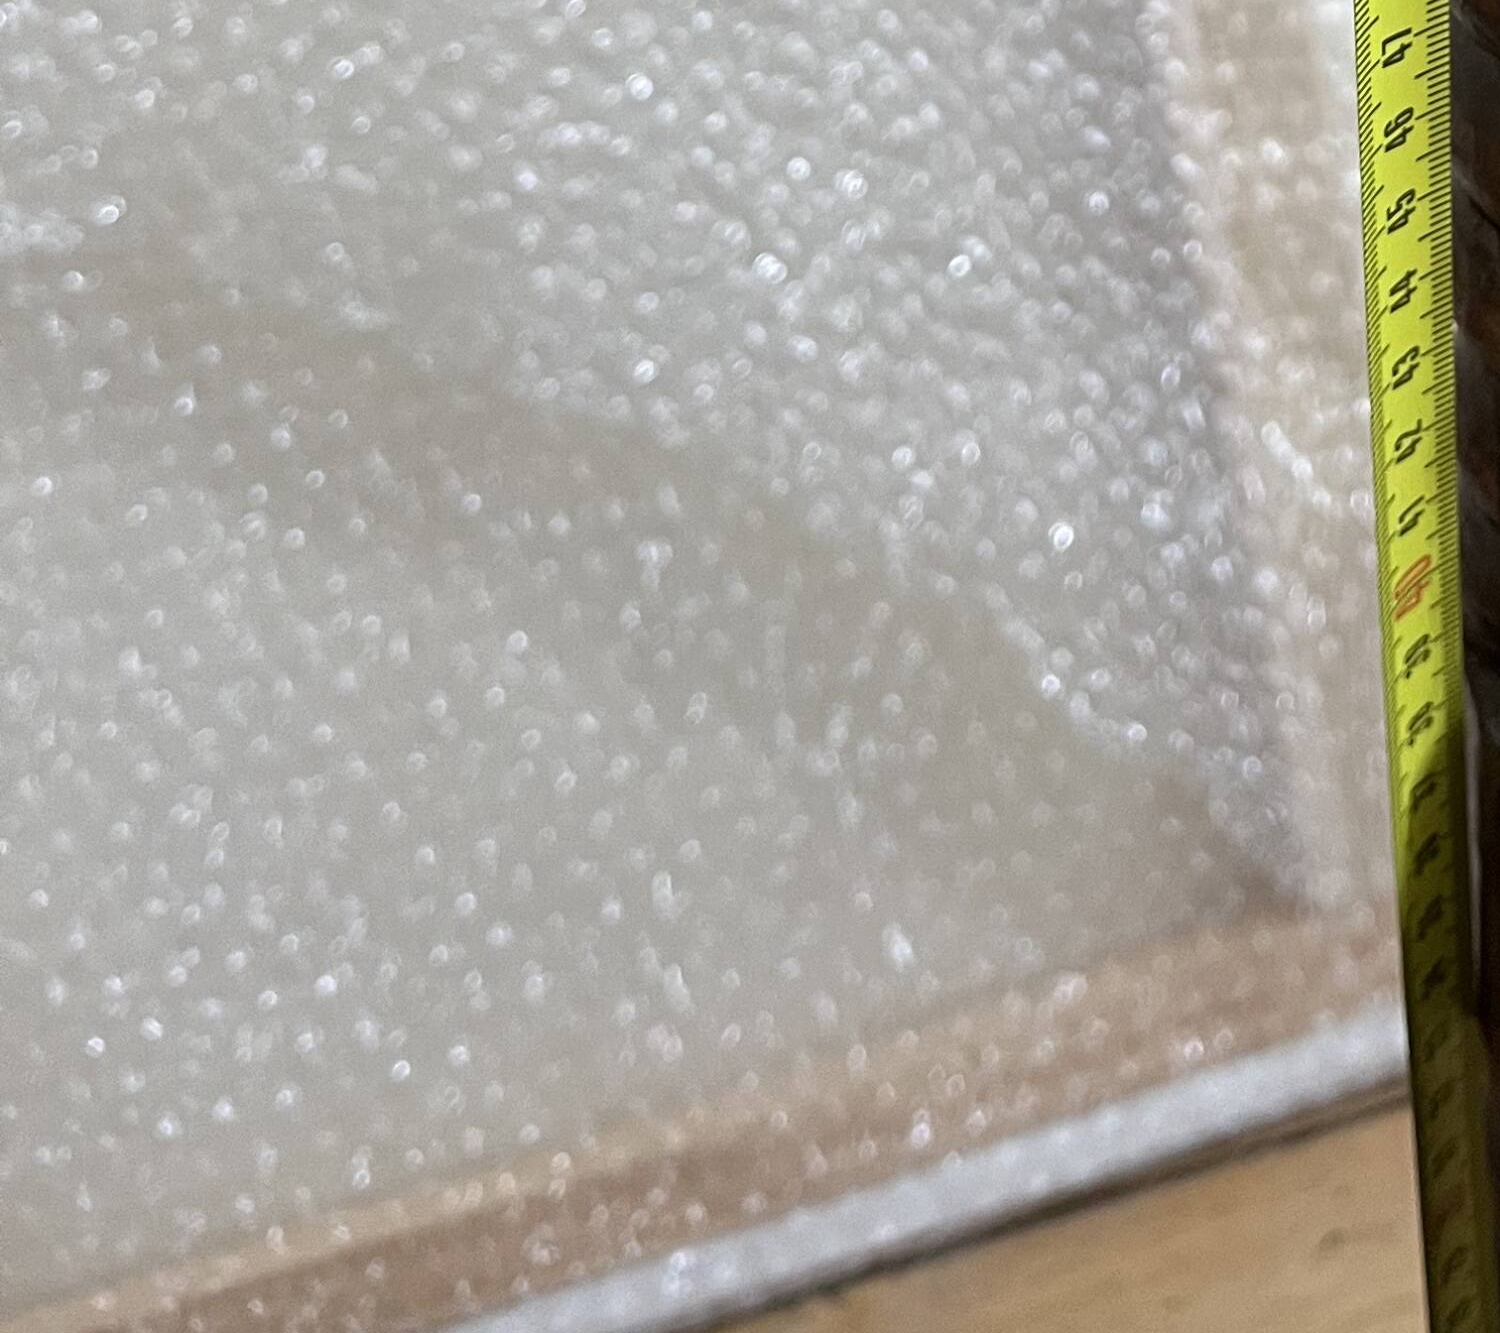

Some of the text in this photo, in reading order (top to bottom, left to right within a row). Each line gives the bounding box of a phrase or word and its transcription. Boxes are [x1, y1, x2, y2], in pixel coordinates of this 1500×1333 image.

[1382, 27, 1412, 69] 47
[1384, 106, 1414, 153] 46
[1387, 188, 1416, 235] 45
[1389, 268, 1417, 314] 44
[1392, 345, 1420, 390] 43
[1394, 418, 1422, 465] 42
